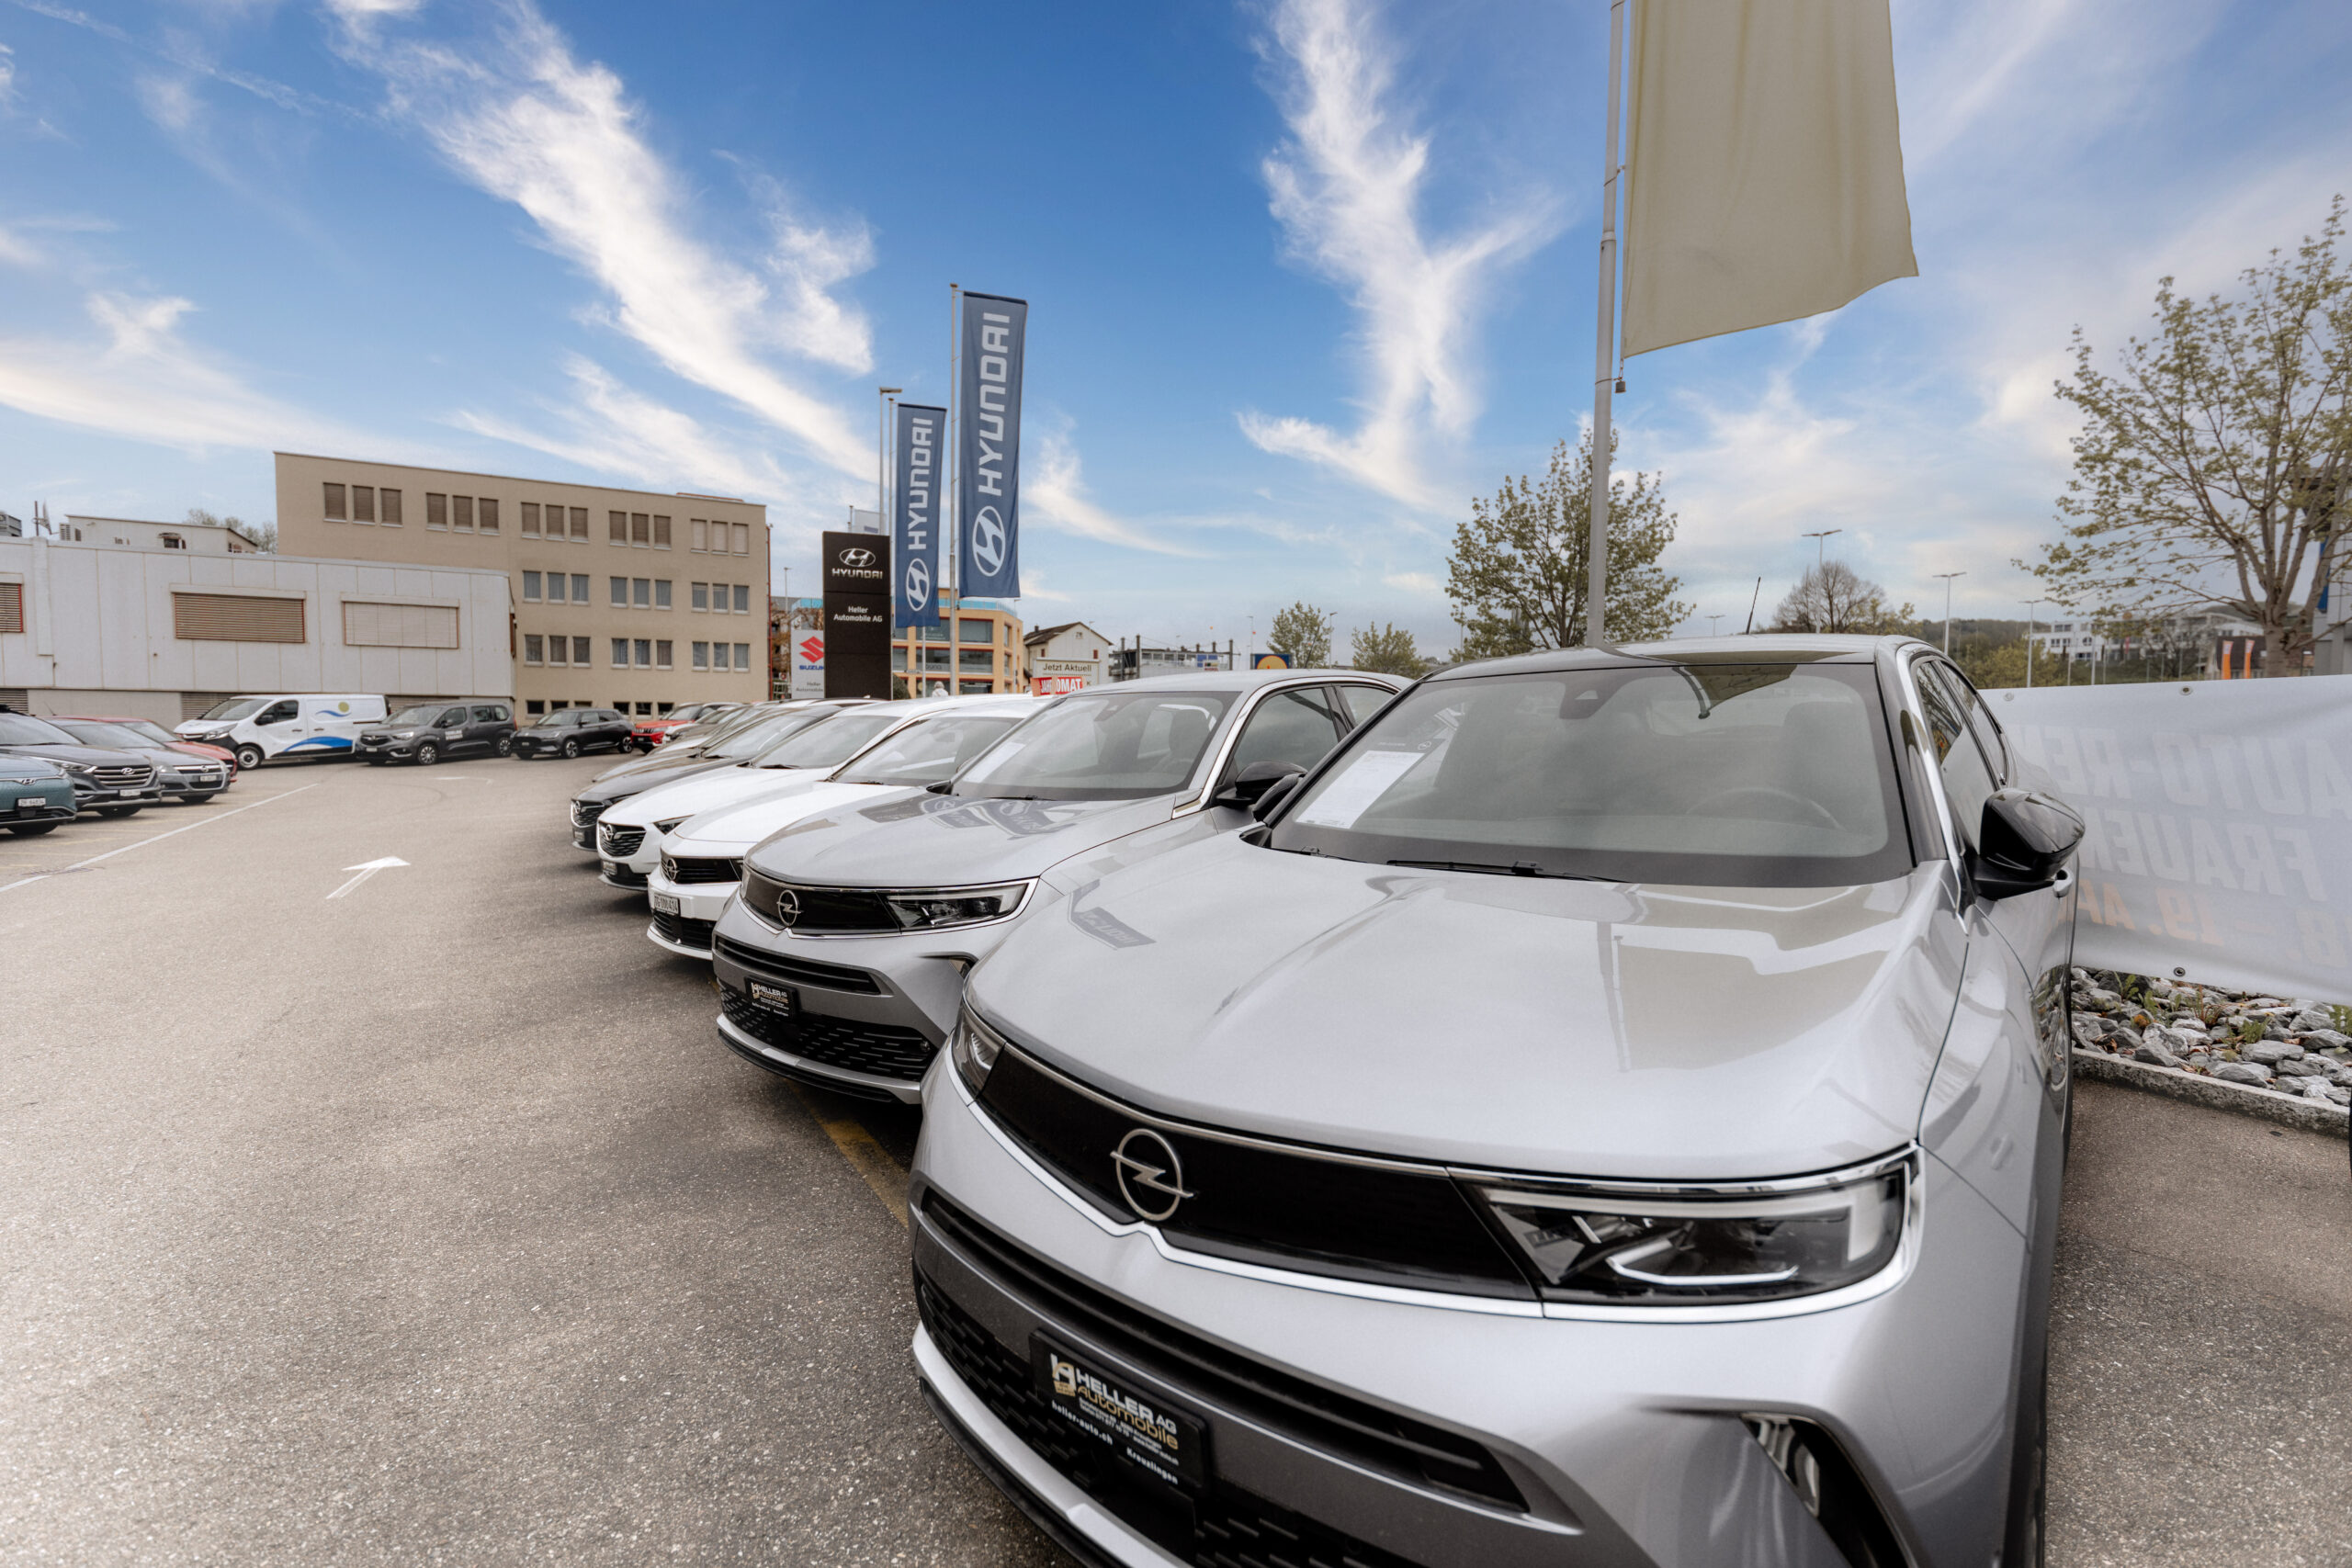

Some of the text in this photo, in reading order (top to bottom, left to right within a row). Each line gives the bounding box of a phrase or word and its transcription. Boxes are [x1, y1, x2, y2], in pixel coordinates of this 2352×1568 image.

[978, 312, 1010, 496] HYUNDAI
[908, 417, 933, 550] HYUNDAI
[831, 568, 883, 580] HYUNDAI
[833, 614, 871, 622] Automobile
[1043, 663, 1092, 671] Jetzt Aktuell
[1076, 1368, 1155, 1425] HELLER
[1156, 1414, 1177, 1435] AG
[1078, 1385, 1179, 1450] Automobile
[1051, 1400, 1114, 1446] heller-auto.ch
[1126, 1447, 1179, 1485] Kreuzlingen
